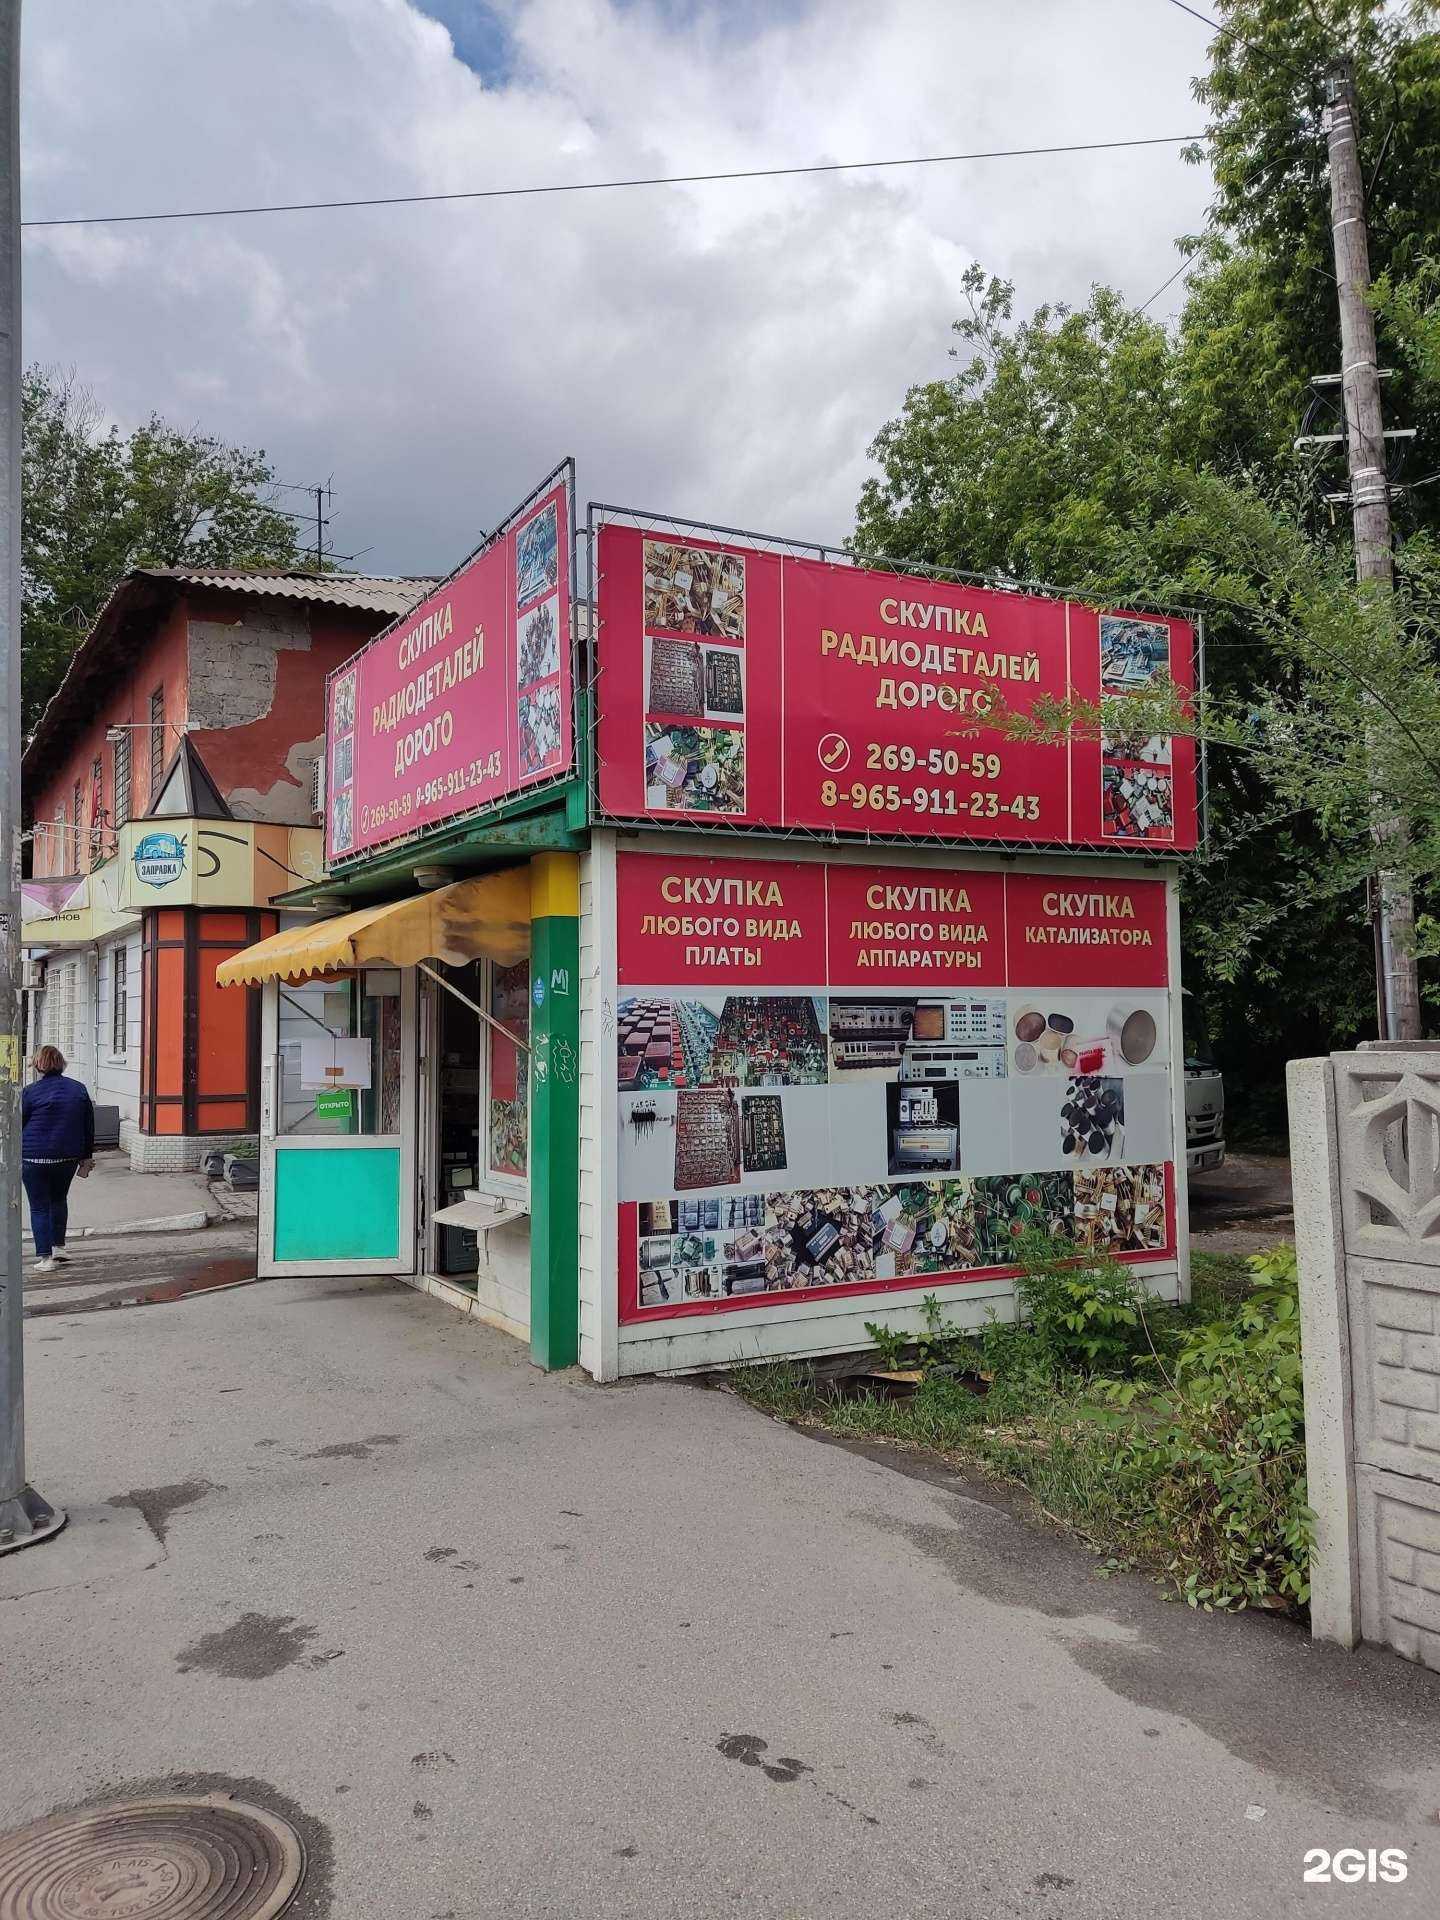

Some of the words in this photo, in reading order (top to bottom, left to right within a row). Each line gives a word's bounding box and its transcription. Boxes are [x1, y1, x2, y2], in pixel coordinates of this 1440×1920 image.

[879, 598, 989, 638] СКУПКА
[398, 602, 453, 671] СКУПКА
[820, 630, 1040, 683] РАДИОДЕТАЛЕЙ
[372, 623, 486, 736] РАДИОДЕТАЛЕЙ
[876, 678, 992, 716] ДОРОГО
[394, 710, 453, 779] ДОРОГО
[866, 743, 1001, 780] 269-50-59
[370, 792, 411, 829] 269-50-59
[820, 780, 1040, 821] 8-965-911-23-43
[141, 863, 177, 876] ЗАПРАВКА
[660, 876, 784, 907] СКУПКА
[866, 885, 973, 913] СКУПКА
[1042, 892, 1136, 919] СКУПКА
[640, 916, 740, 938] ЛЮБОГО
[745, 918, 802, 941] ВИДА
[848, 921, 934, 942] ЛЮБОГО
[939, 923, 989, 944] ВИДА
[1025, 926, 1153, 947] КАТАЛИЗАТОРА
[685, 946, 762, 968] ПЛАТЫ
[856, 949, 983, 969] АППАРАТУРЫ
[319, 1101, 350, 1110] ОТКРЫТО
